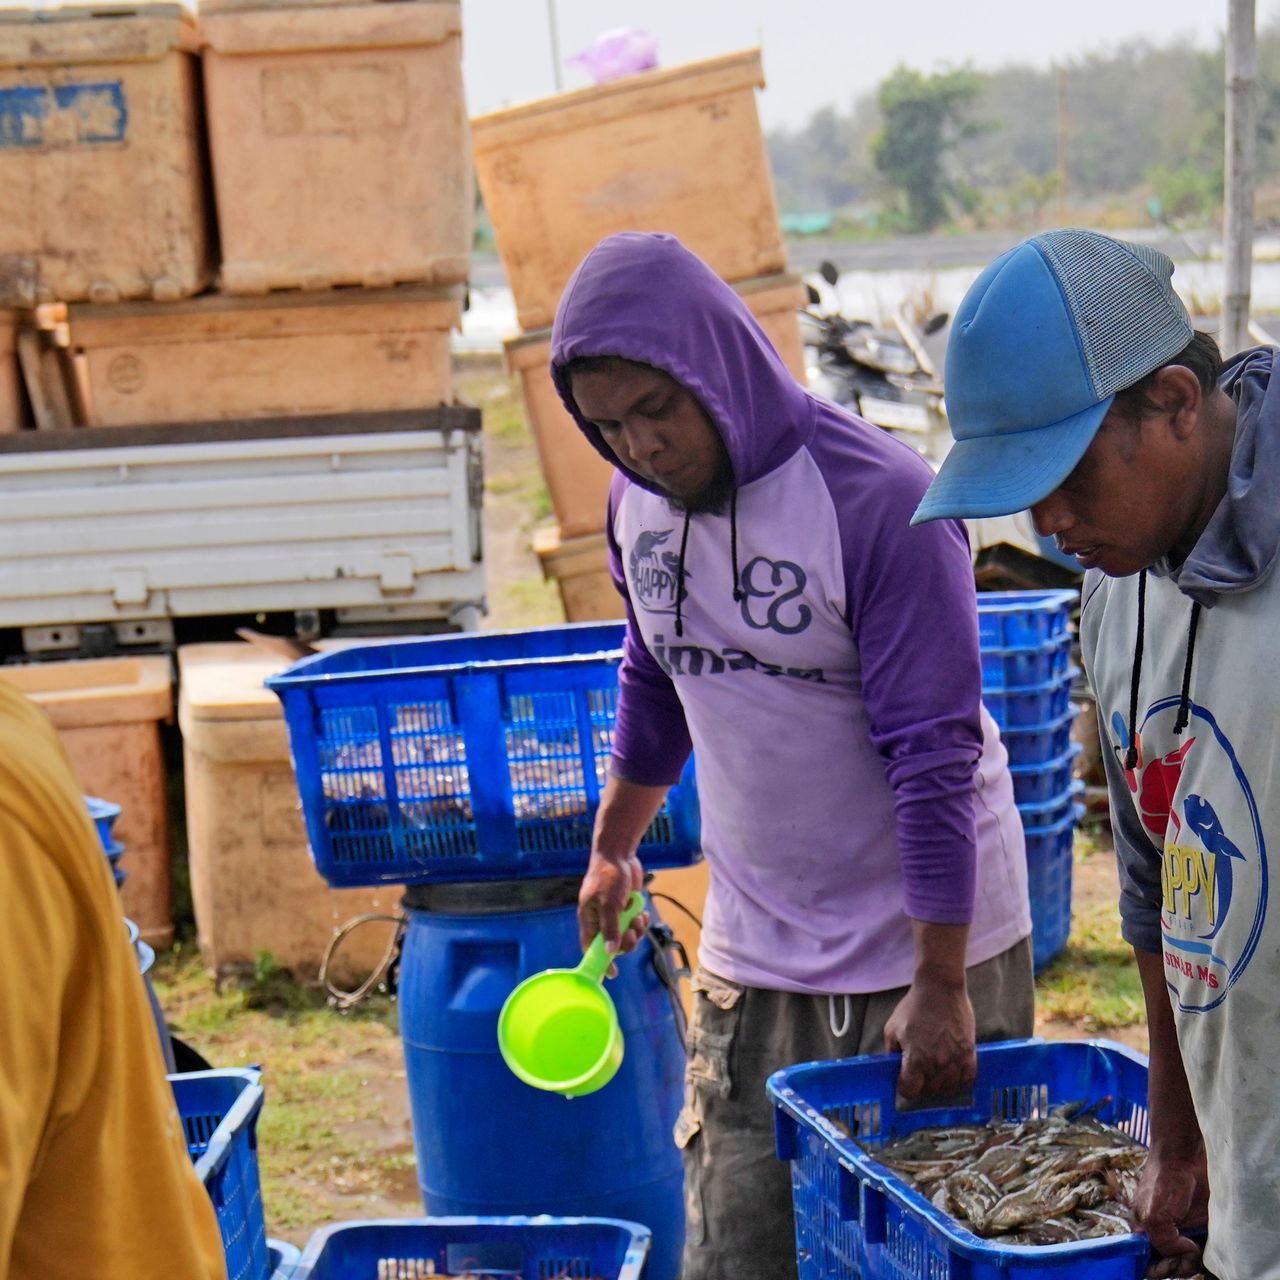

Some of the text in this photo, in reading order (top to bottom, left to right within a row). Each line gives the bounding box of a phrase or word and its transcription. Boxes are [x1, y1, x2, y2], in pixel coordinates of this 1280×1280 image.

[635, 566, 678, 601] HAPPY
[1161, 843, 1216, 926] PPY
[1164, 951, 1219, 989] SINAR MS
